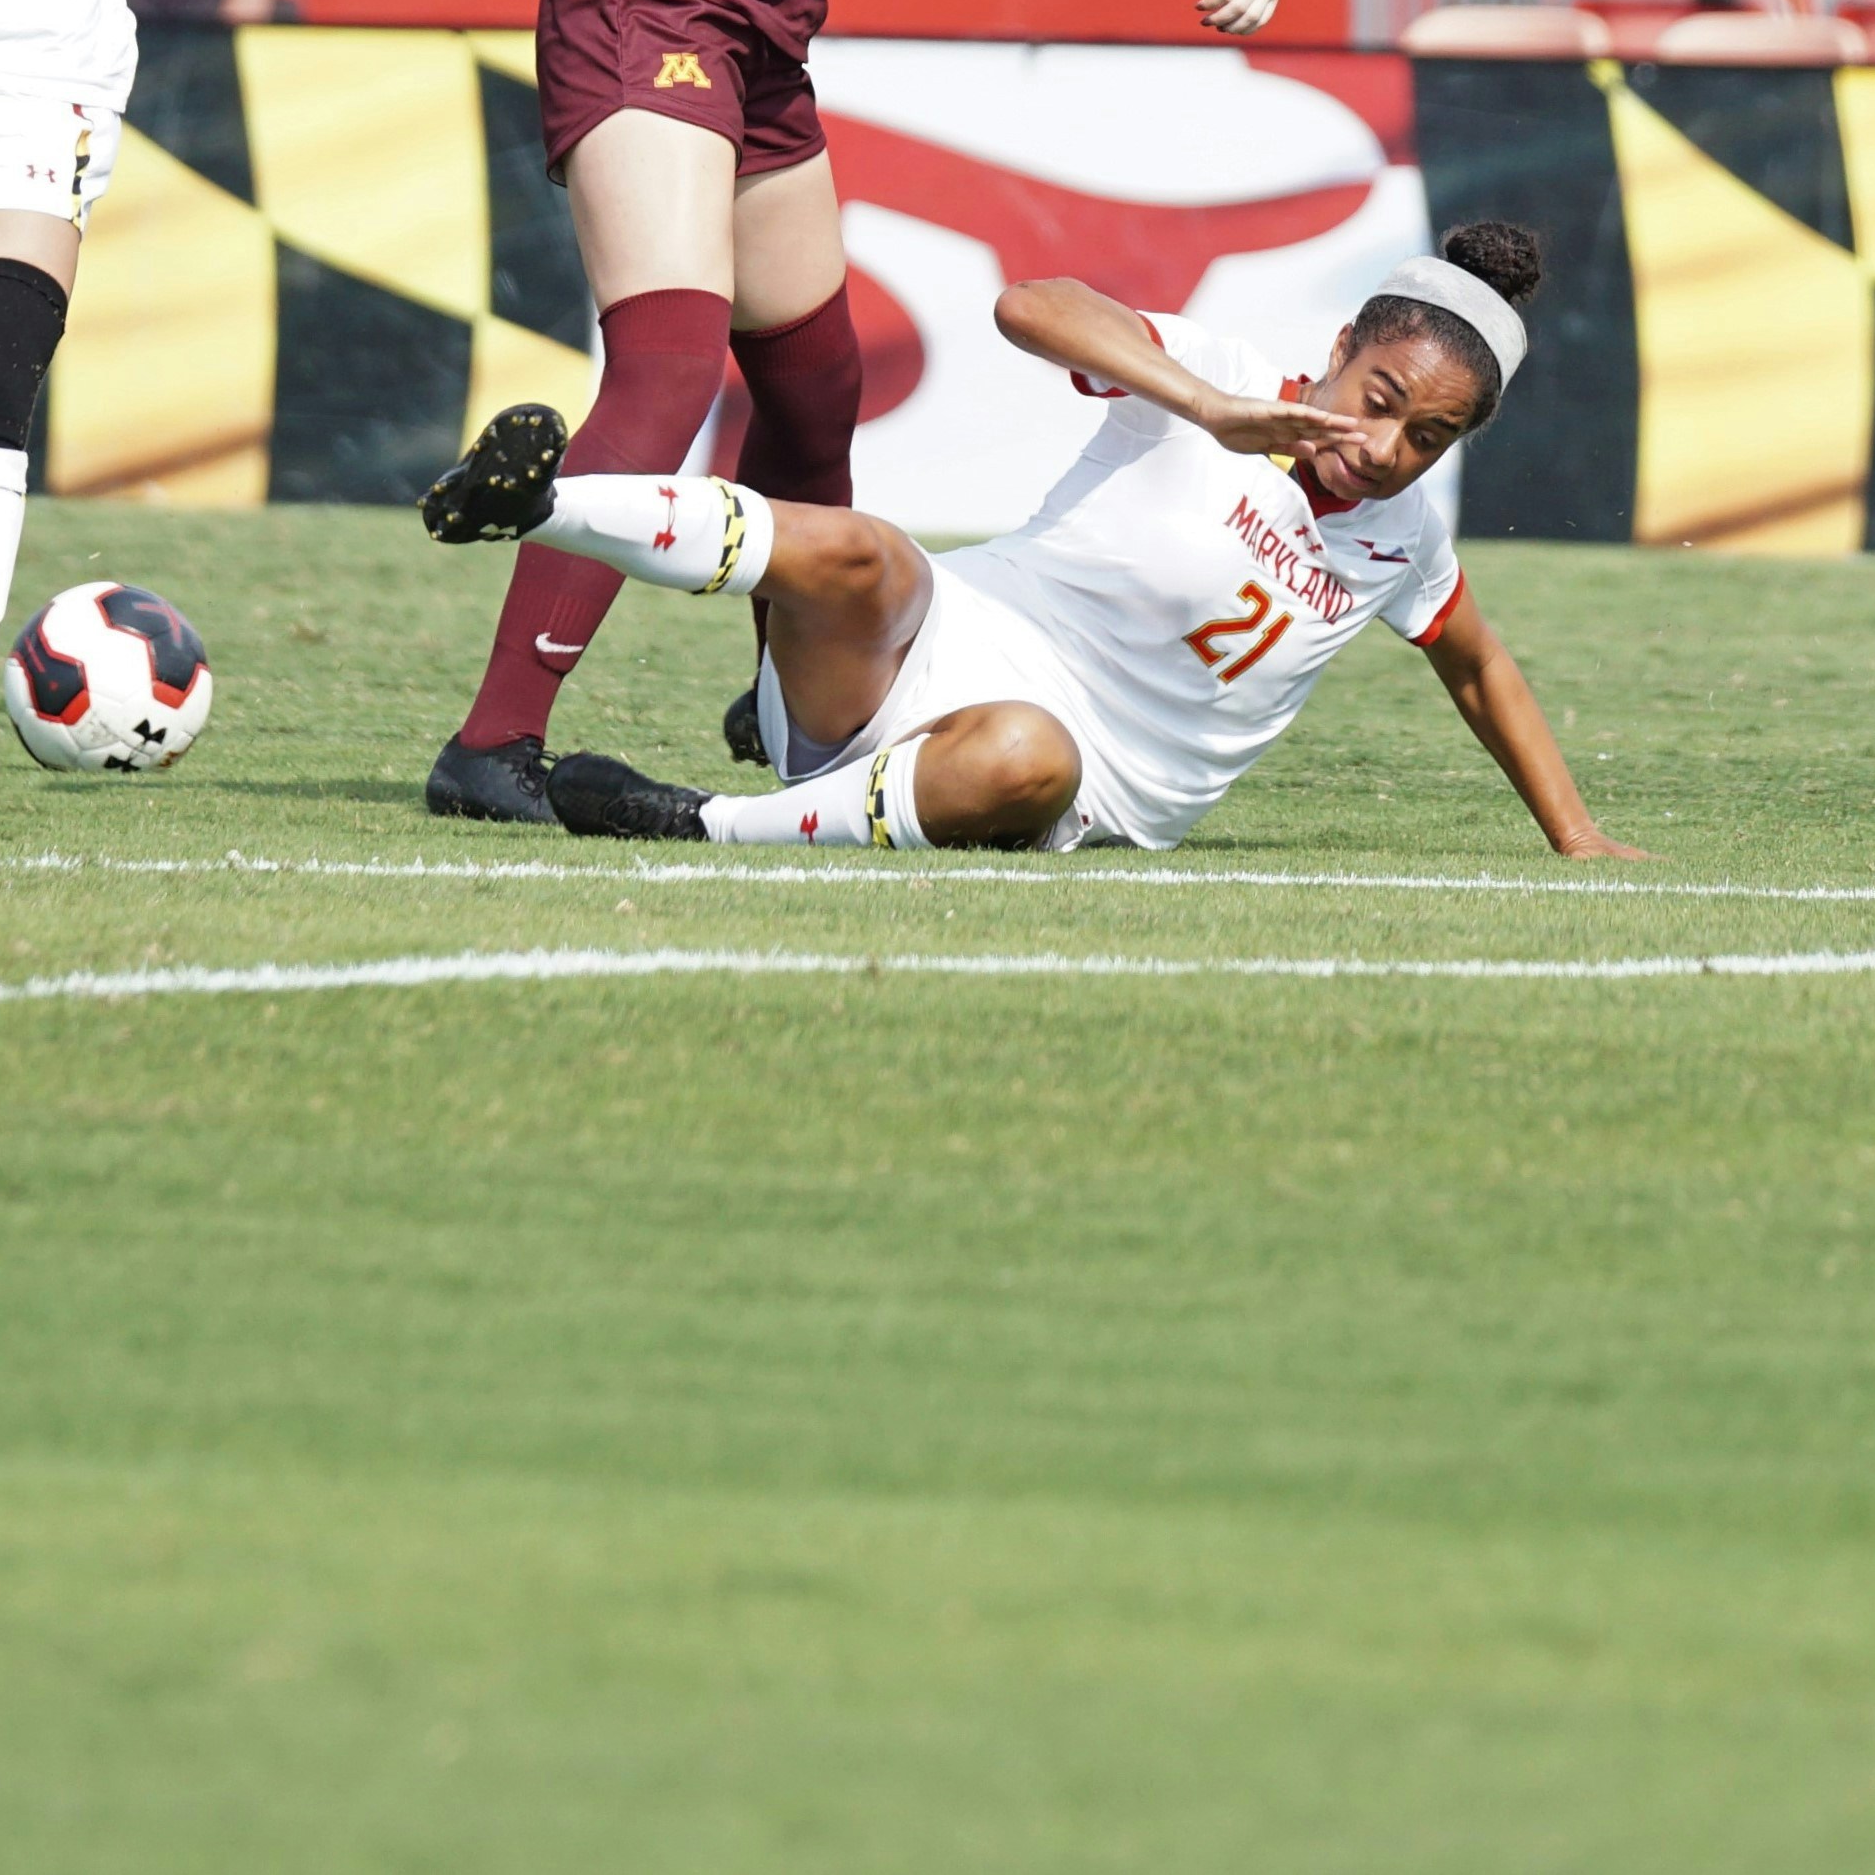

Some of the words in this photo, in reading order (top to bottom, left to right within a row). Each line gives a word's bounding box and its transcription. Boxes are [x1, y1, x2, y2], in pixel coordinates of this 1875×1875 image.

[653, 52, 712, 89] M
[1224, 494, 1353, 625] MARYLAND
[1181, 580, 1294, 685] 21
